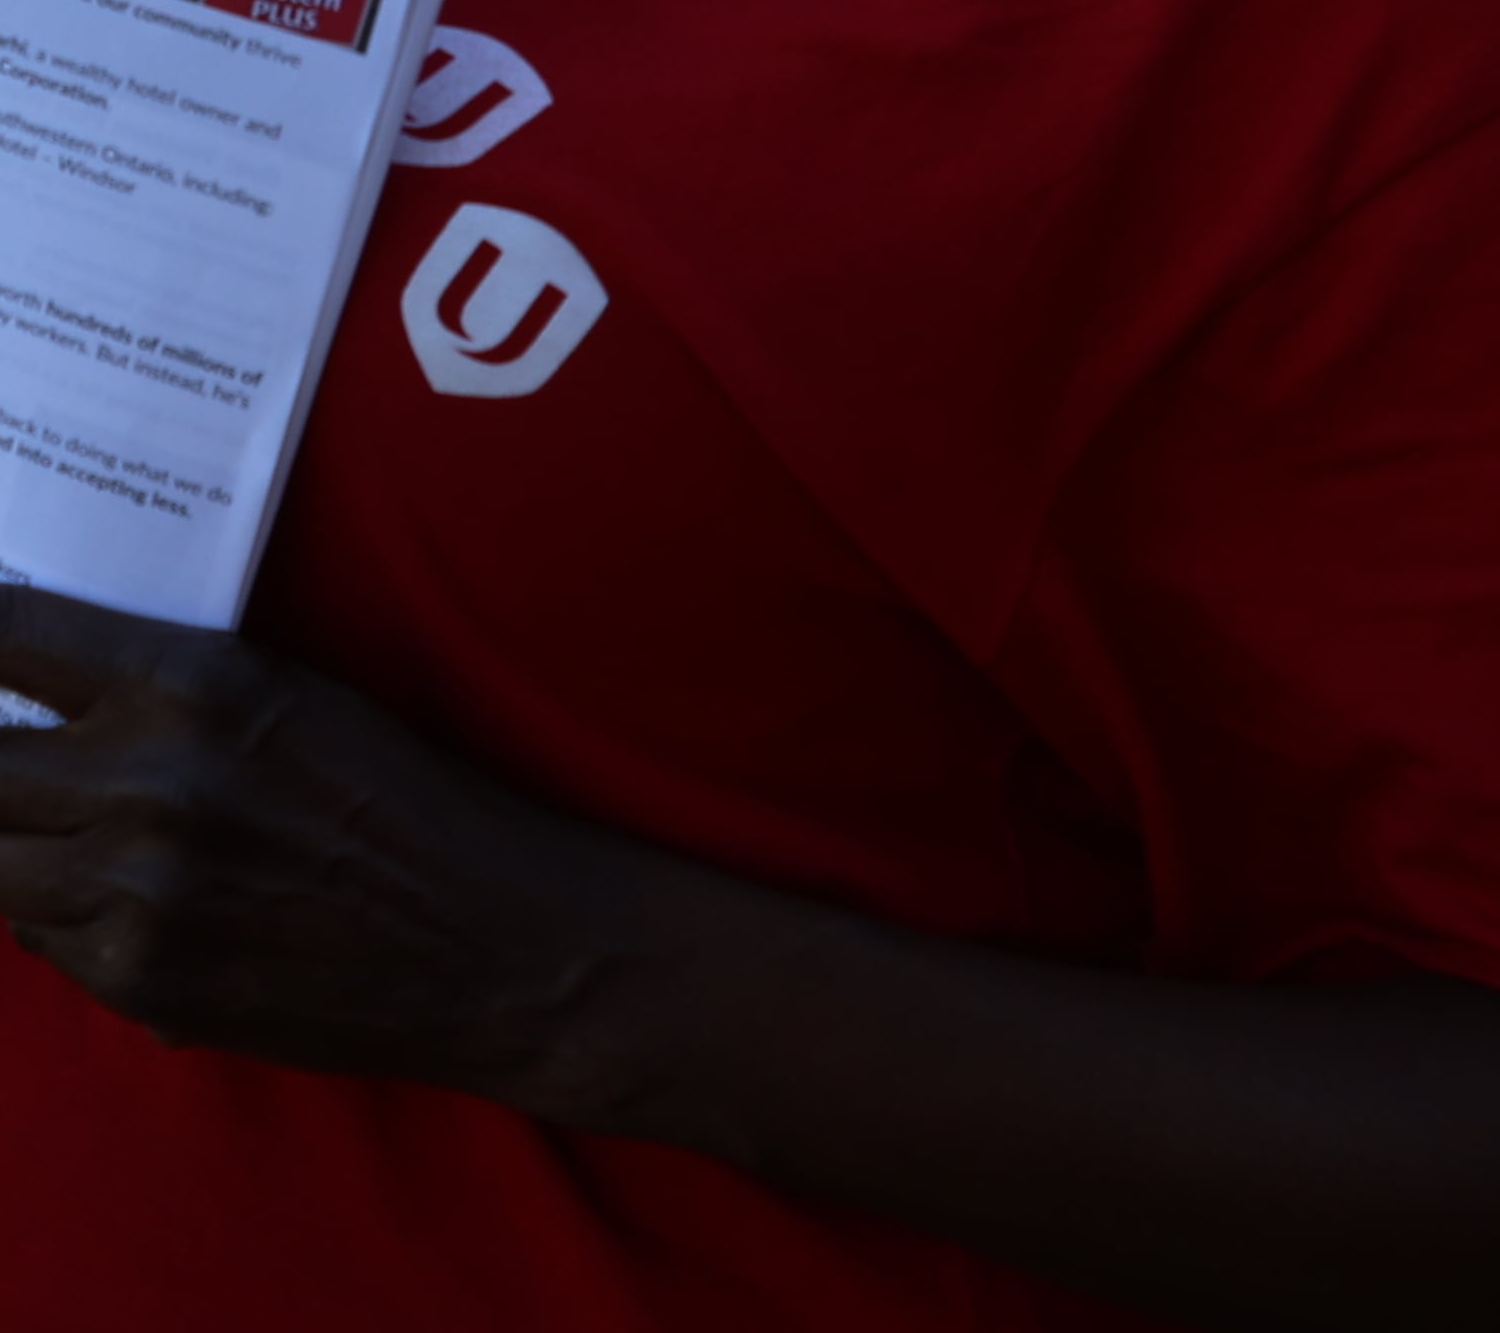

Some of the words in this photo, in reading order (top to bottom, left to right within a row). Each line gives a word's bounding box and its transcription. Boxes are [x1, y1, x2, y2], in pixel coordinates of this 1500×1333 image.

[133, 6, 242, 49] community
[245, 38, 301, 65] thrive
[34, 50, 47, 62] a
[50, 56, 122, 88] wealthy
[126, 77, 177, 104] hotel
[178, 98, 240, 124] owner
[243, 119, 283, 138] and
[58, 157, 135, 193] Windsor
[16, 443, 53, 467] into
[56, 463, 148, 505] accepting
[150, 492, 190, 517] less.
